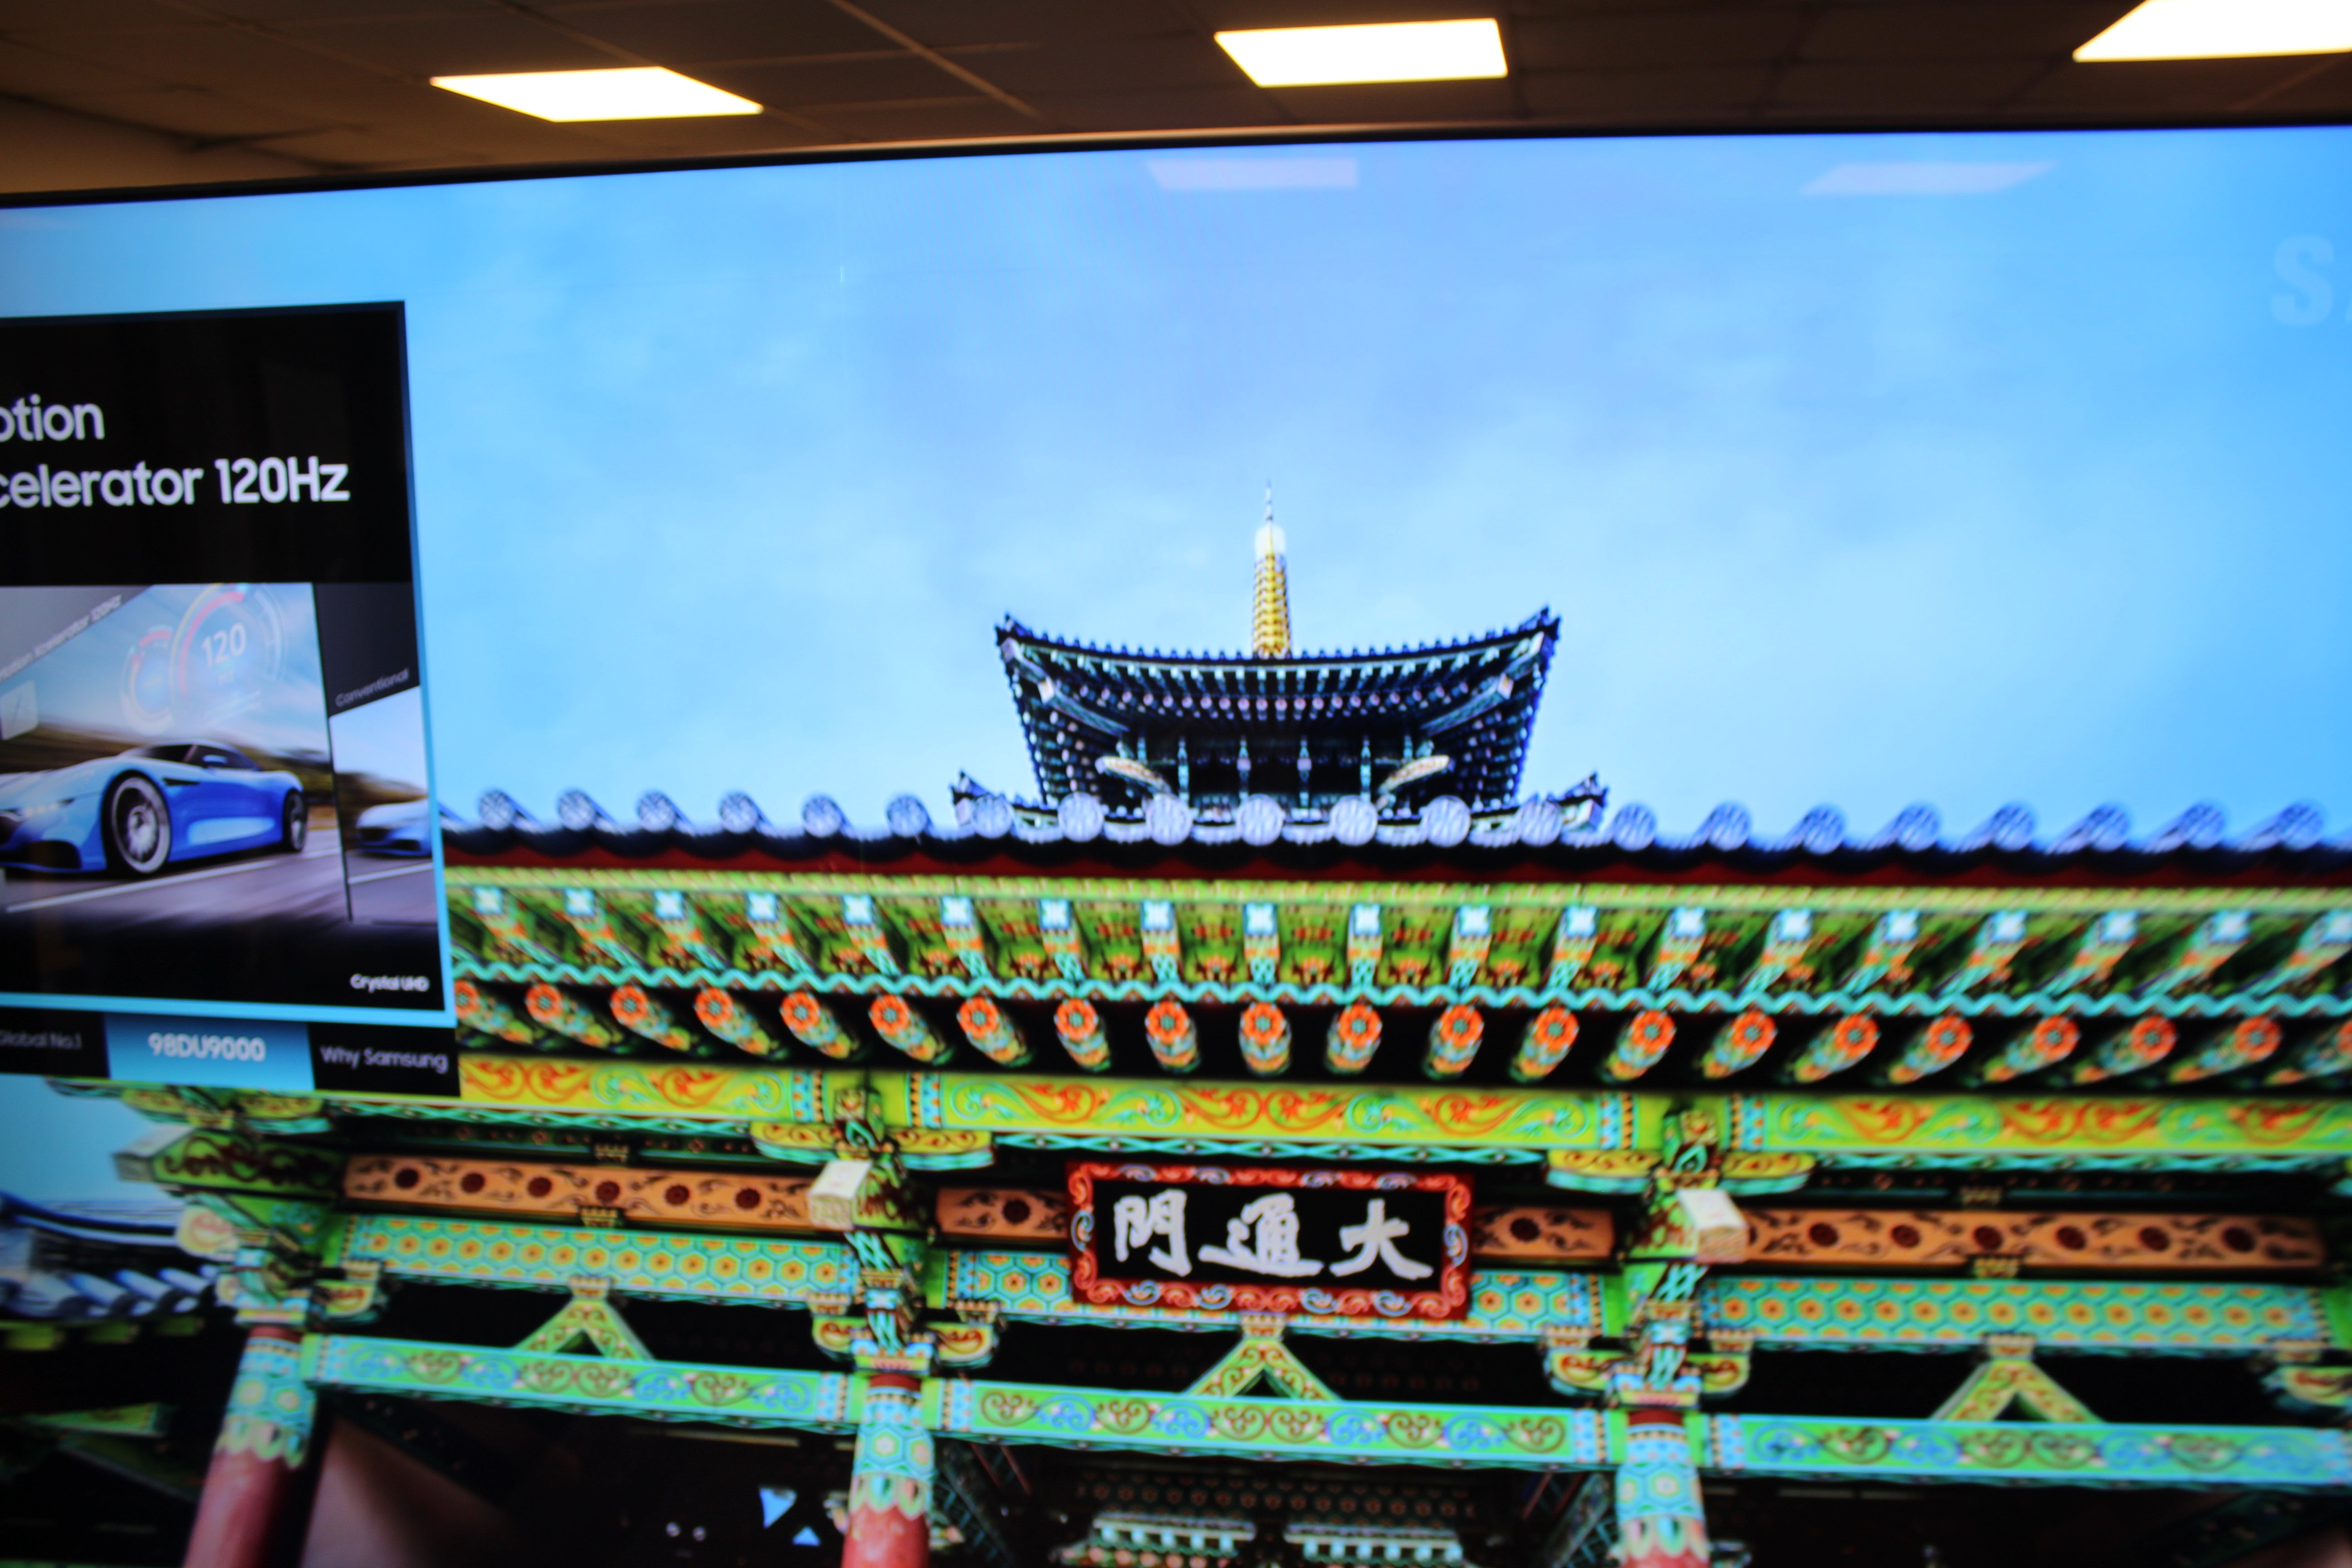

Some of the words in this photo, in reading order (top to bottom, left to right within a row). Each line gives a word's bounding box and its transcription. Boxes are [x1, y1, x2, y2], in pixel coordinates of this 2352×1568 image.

[2270, 235, 2352, 328] S
[214, 456, 351, 505] 120Hz
[201, 622, 246, 668] 120
[335, 668, 409, 707] Conventional
[148, 1032, 266, 1062] 98DU9000
[320, 1045, 361, 1069] Why
[363, 1047, 449, 1074] Samsung
